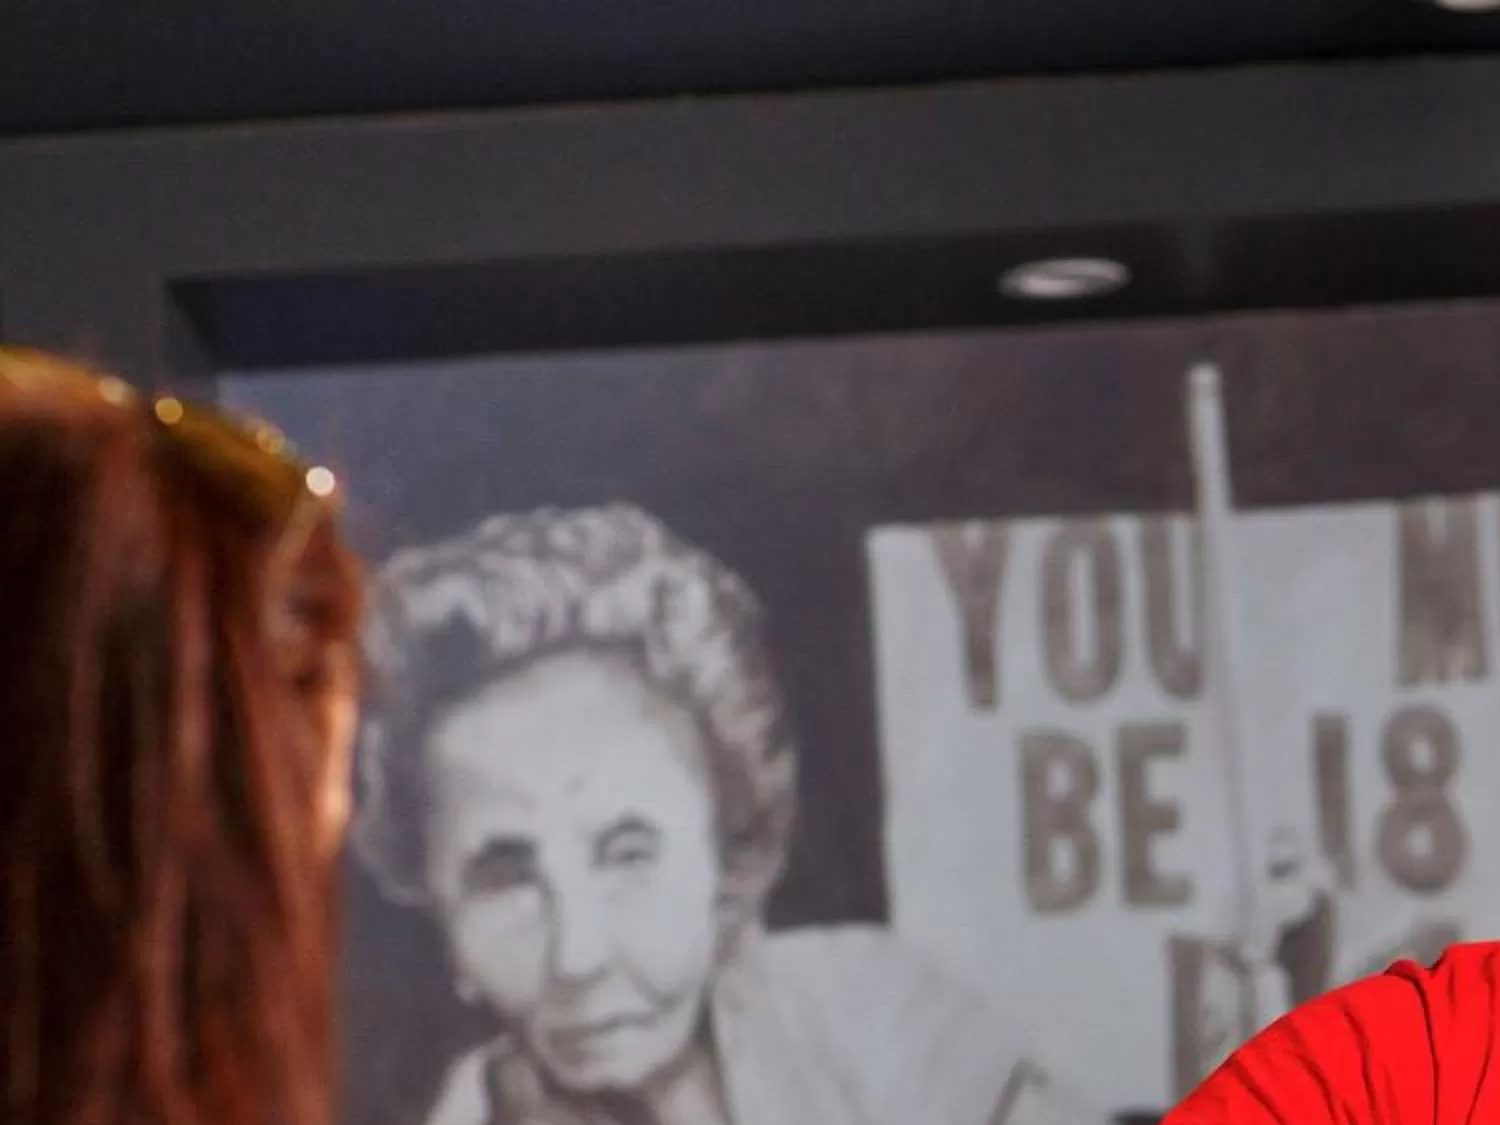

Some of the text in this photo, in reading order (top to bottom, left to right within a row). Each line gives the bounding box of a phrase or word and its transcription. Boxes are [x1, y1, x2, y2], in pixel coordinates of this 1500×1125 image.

[930, 514, 1206, 712] YOU
[1018, 720, 1191, 914] BE
[1309, 703, 1470, 894] 18
